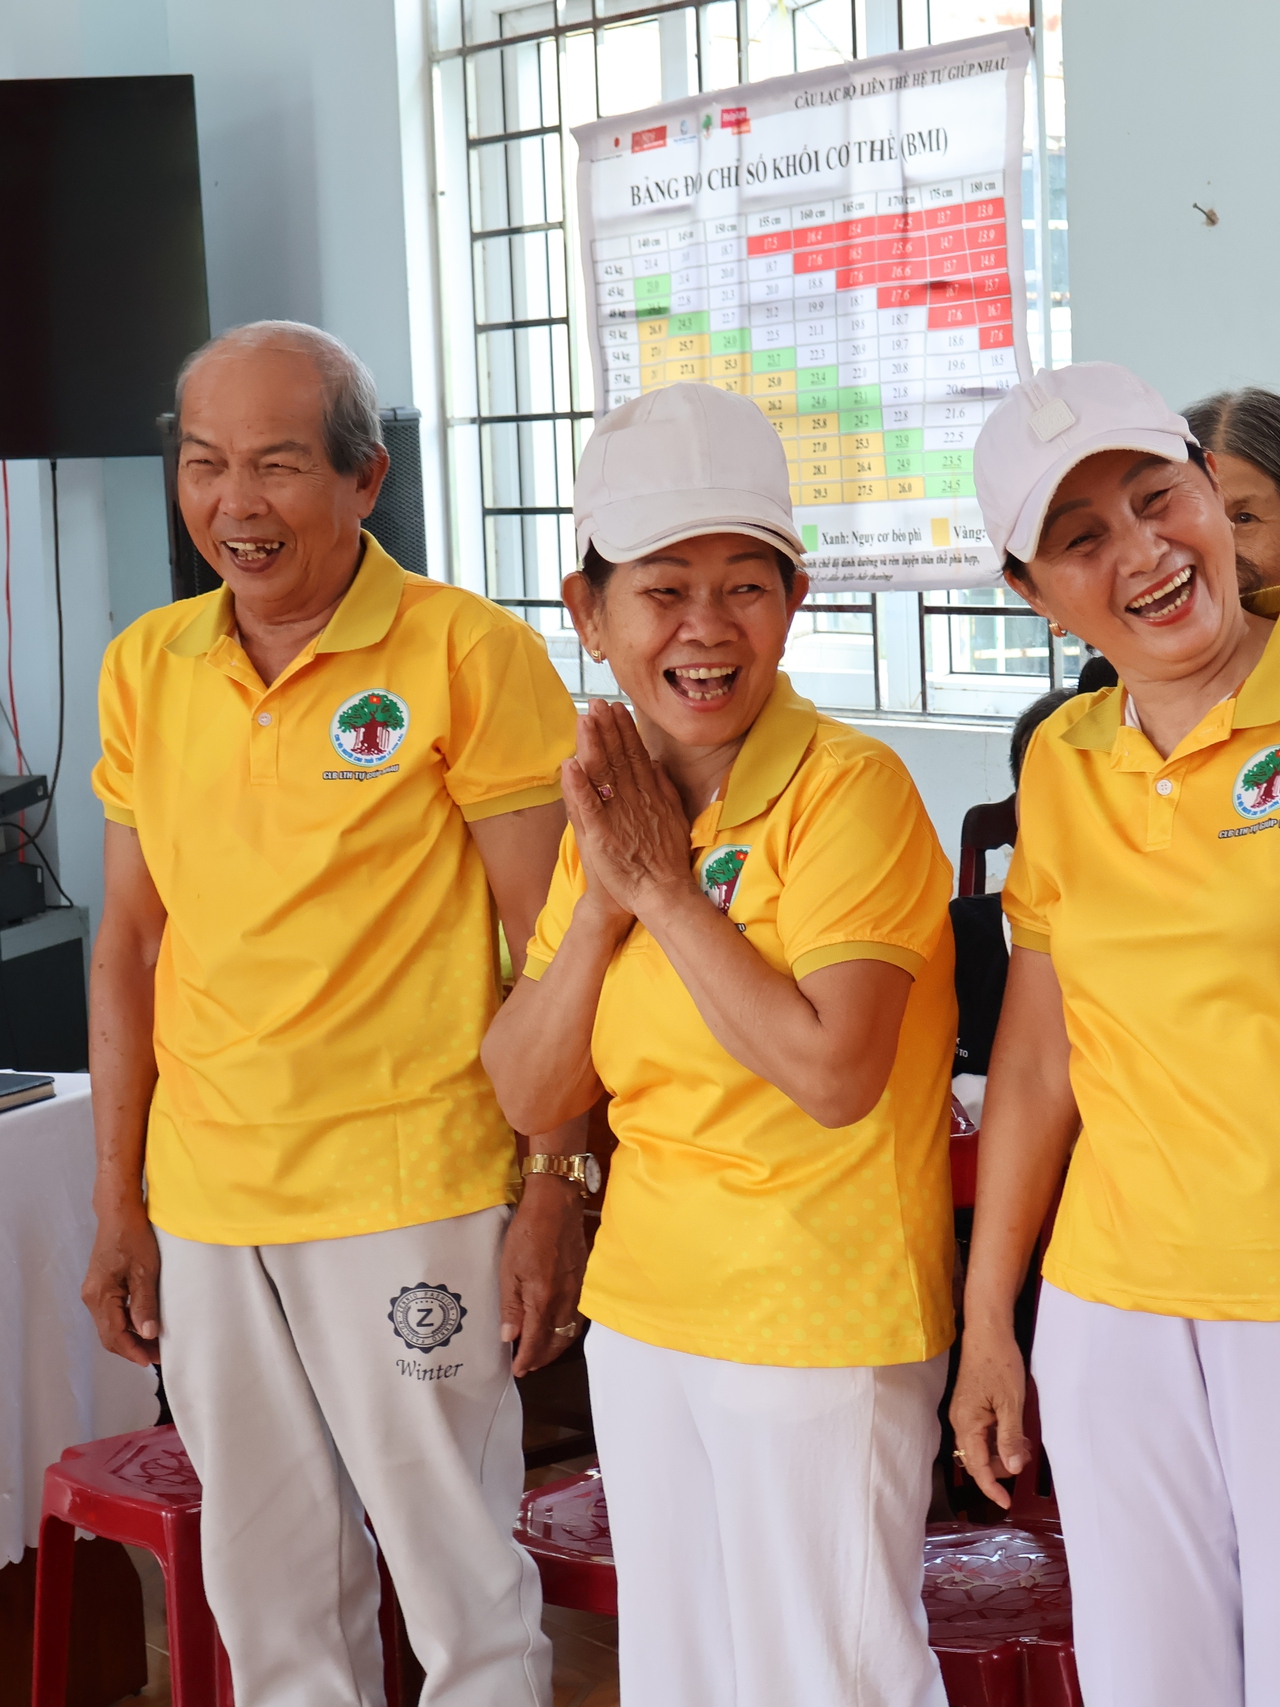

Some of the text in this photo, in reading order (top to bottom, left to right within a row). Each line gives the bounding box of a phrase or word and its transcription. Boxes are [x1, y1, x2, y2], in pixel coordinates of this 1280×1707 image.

[630, 127, 947, 206] BẢNG ĐO CHỈ SỐ KHỐI CƠ THỂ (BMI)
[892, 314, 909, 325] 18.7
[892, 335, 964, 350] 19.7 18.6
[892, 360, 965, 374] 20.8 19.6
[893, 387, 908, 398] 21.8
[945, 408, 965, 419] 21.6
[944, 432, 963, 443] 22.5
[813, 456, 962, 475] 28.1 26.4 23.5
[814, 480, 960, 498] 29.3 27.5 24.5
[821, 532, 849, 545] Xanh:
[852, 531, 874, 546] Nguy
[878, 533, 889, 542] cơ
[908, 528, 922, 545] phì
[954, 526, 985, 539] Vàng:
[417, 1308, 434, 1327] Z
[396, 1359, 463, 1381] Winter
